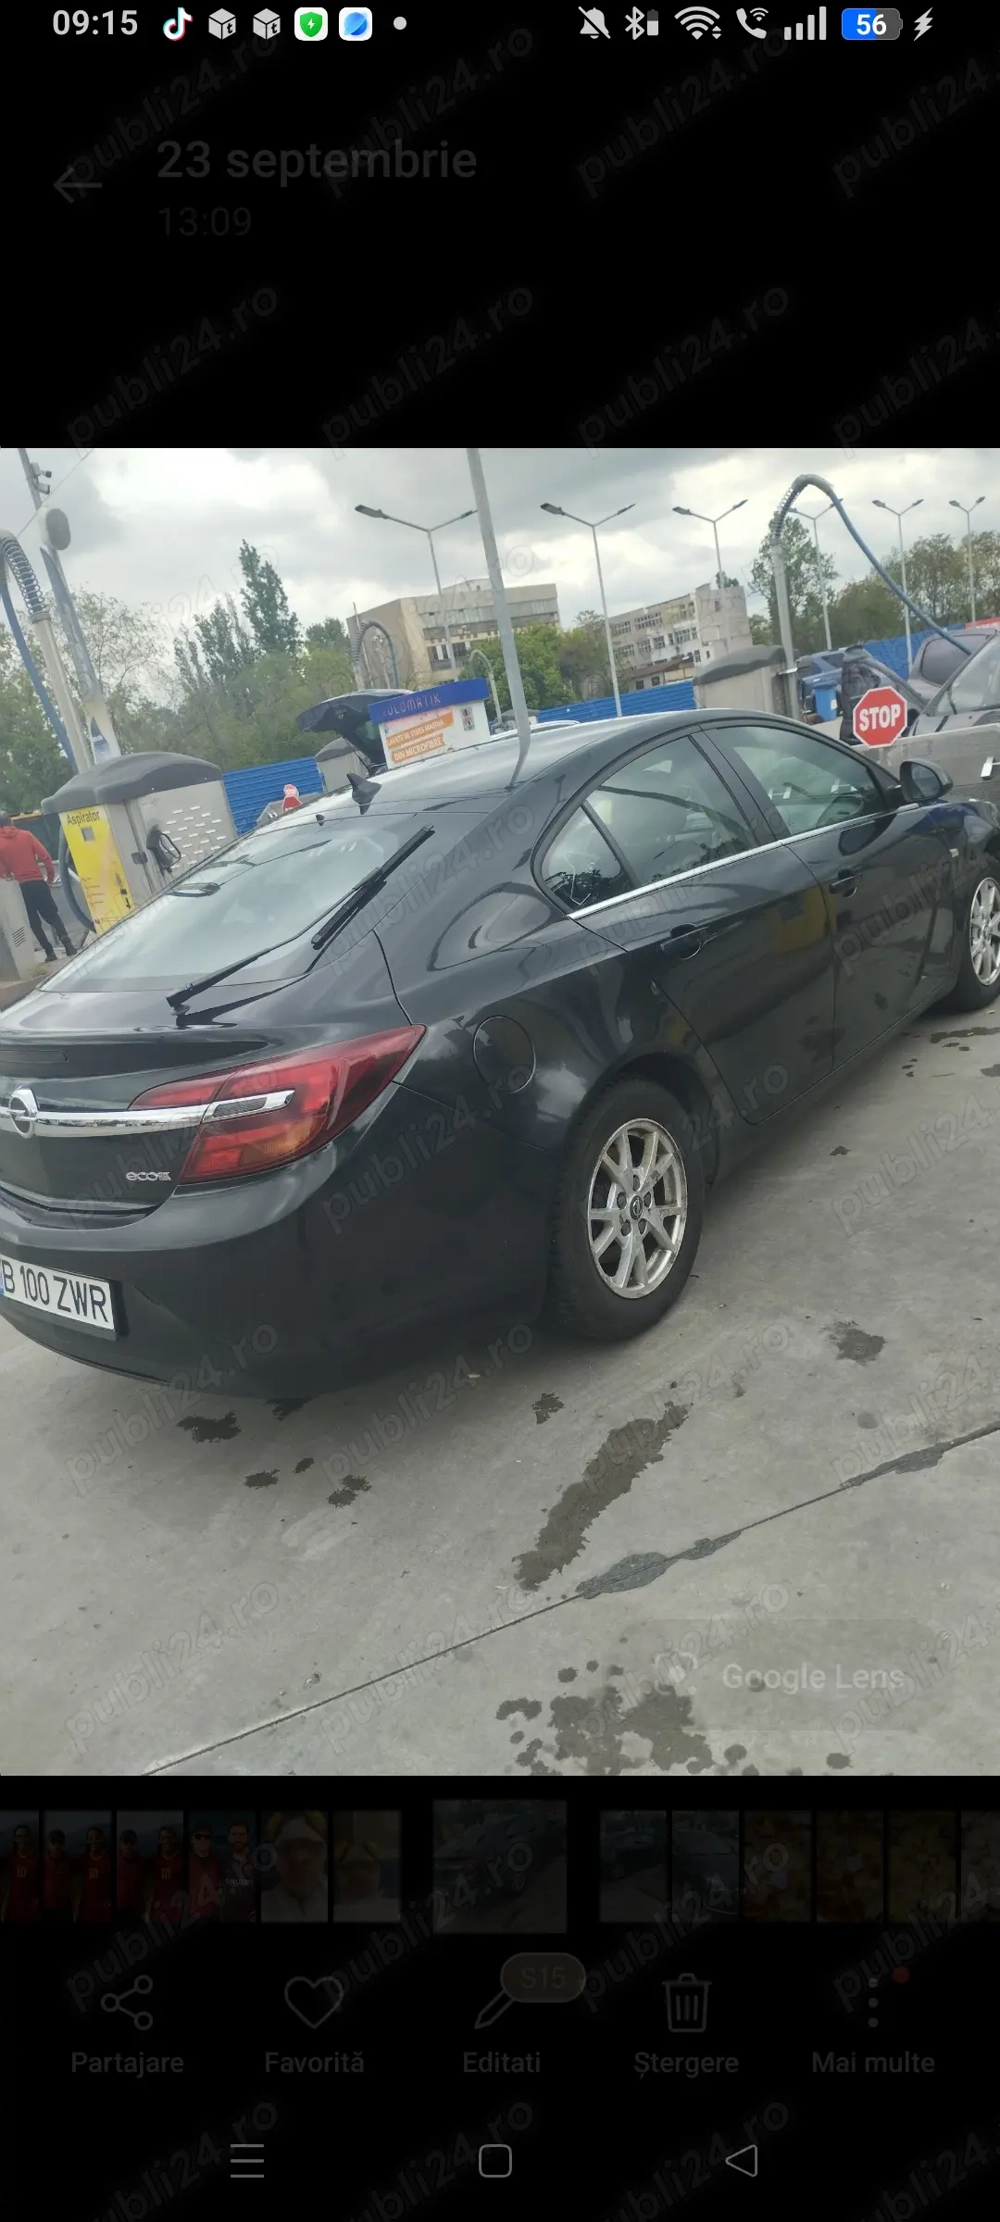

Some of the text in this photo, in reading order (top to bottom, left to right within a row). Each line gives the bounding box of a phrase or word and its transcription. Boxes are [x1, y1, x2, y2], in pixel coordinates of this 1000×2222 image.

[52, 9, 138, 36] 09:15
[856, 14, 887, 35] 56
[157, 138, 477, 188] 23 septembrie
[157, 206, 253, 237] 13:09
[858, 703, 902, 732] STOP
[66, 810, 101, 827] Aspirator
[2, 1259, 109, 1323] B 100 ZWR
[520, 1966, 567, 1990] S15
[71, 2051, 185, 2079] Partajare
[264, 2051, 365, 2073] Favorită
[462, 2051, 541, 2073] Editati
[633, 2051, 740, 2079] Ștergere
[811, 2051, 936, 2073] Mai multe
